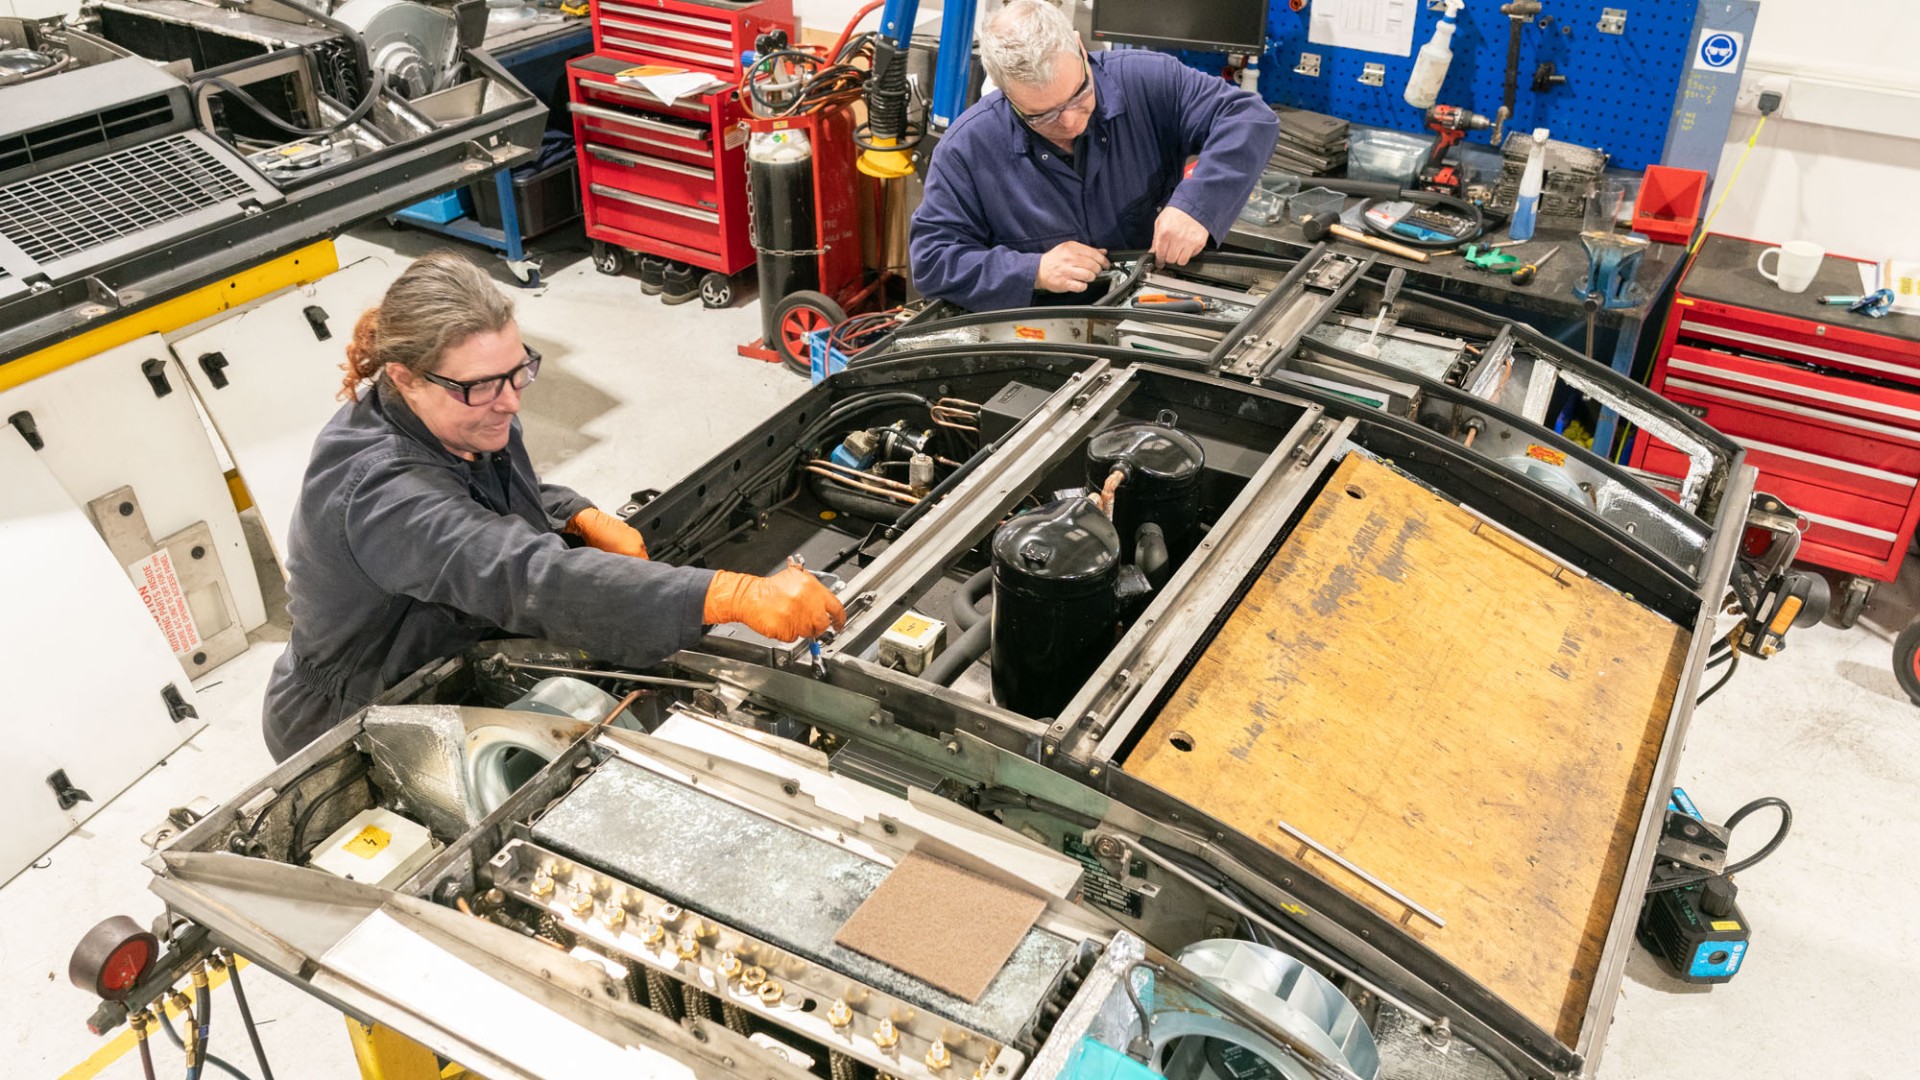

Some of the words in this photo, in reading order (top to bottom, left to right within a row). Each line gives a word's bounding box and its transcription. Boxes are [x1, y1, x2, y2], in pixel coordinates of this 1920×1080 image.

[160, 554, 172, 573] PANEL
[142, 564, 158, 590] INSIDE
[157, 573, 166, 585] FOR
[167, 573, 180, 596] ACCESS
[161, 585, 170, 596] OFF
[152, 591, 167, 616] PARTS
[168, 604, 178, 617] UNIT
[175, 597, 190, 622] OPENING
[162, 616, 181, 652] ROTATING
[173, 618, 182, 629] A/C
[184, 622, 198, 645] BEFORE
[177, 630, 191, 652] ENSURE
